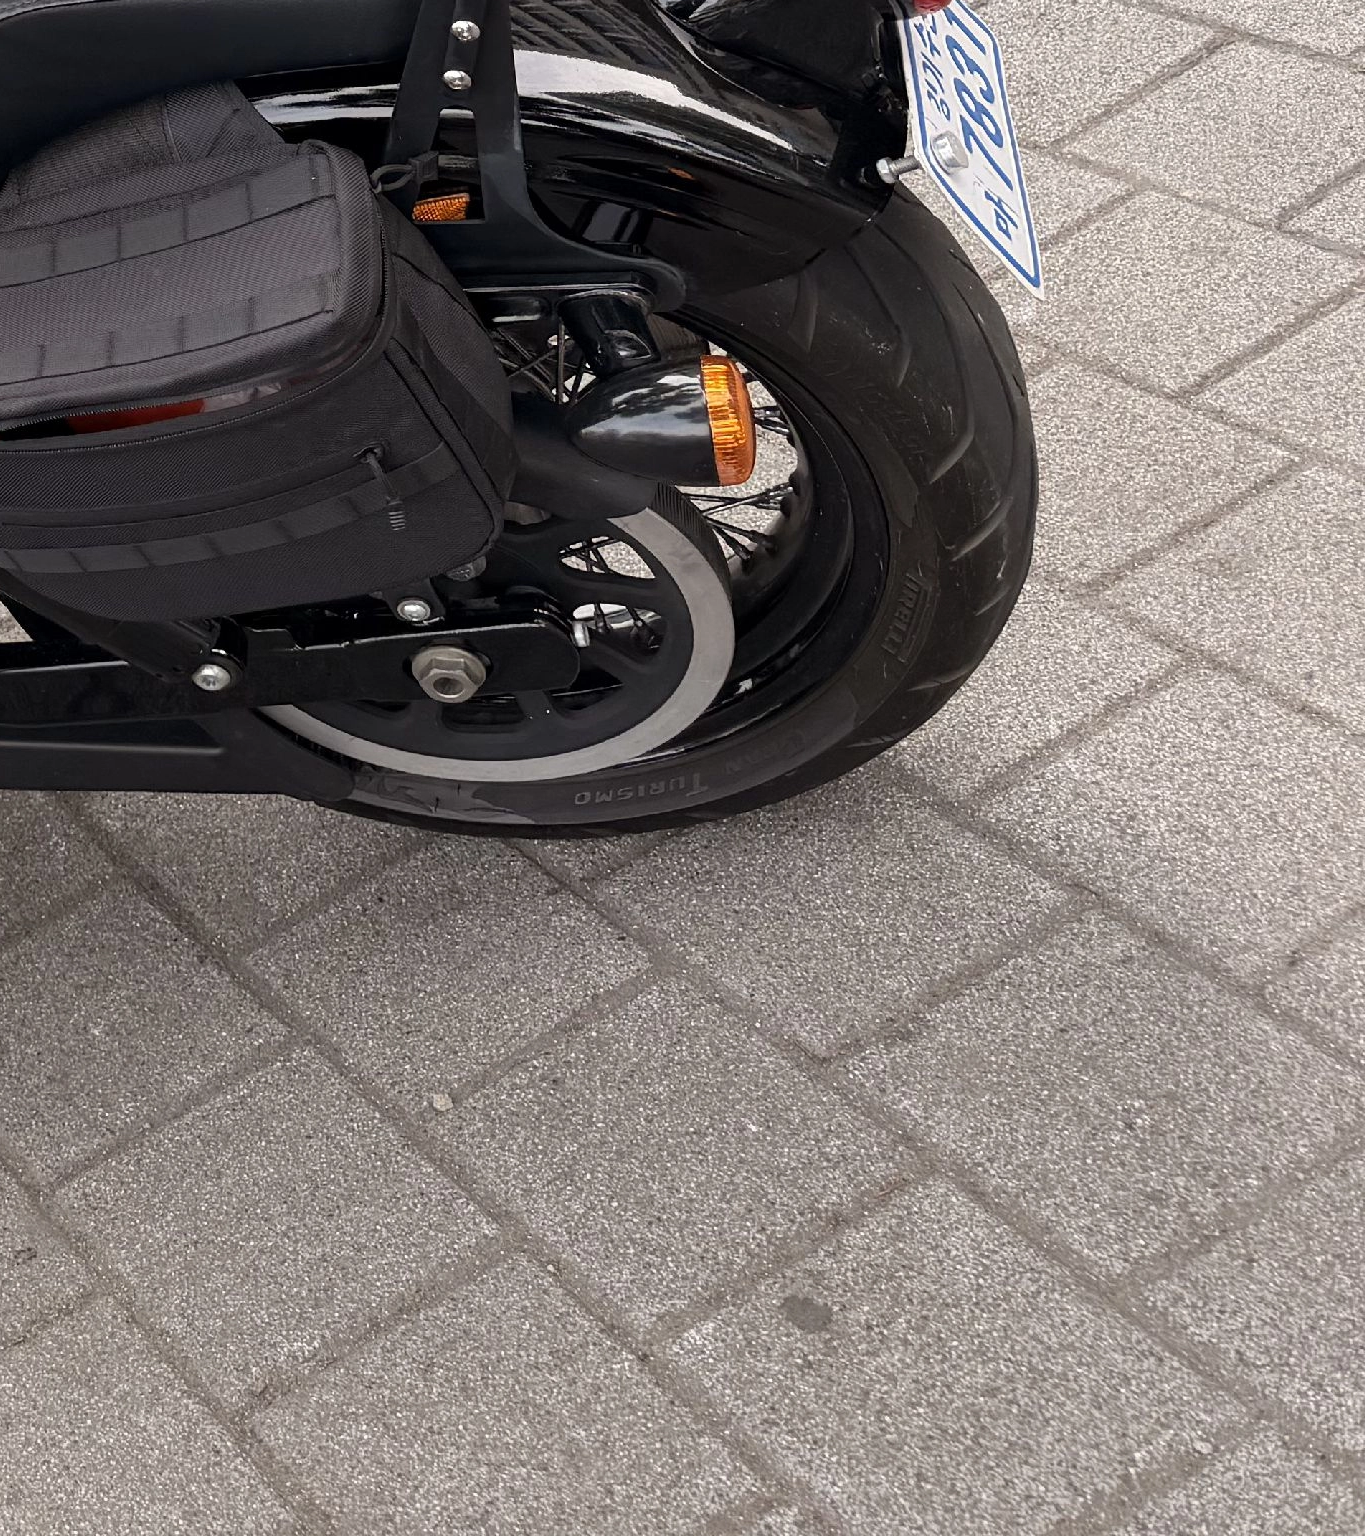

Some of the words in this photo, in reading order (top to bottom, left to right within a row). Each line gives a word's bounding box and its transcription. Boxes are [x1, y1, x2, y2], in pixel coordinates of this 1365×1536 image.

[943, 6, 1014, 192] 7831
[984, 189, 1019, 241] 마
[574, 771, 710, 806] TURISMO
